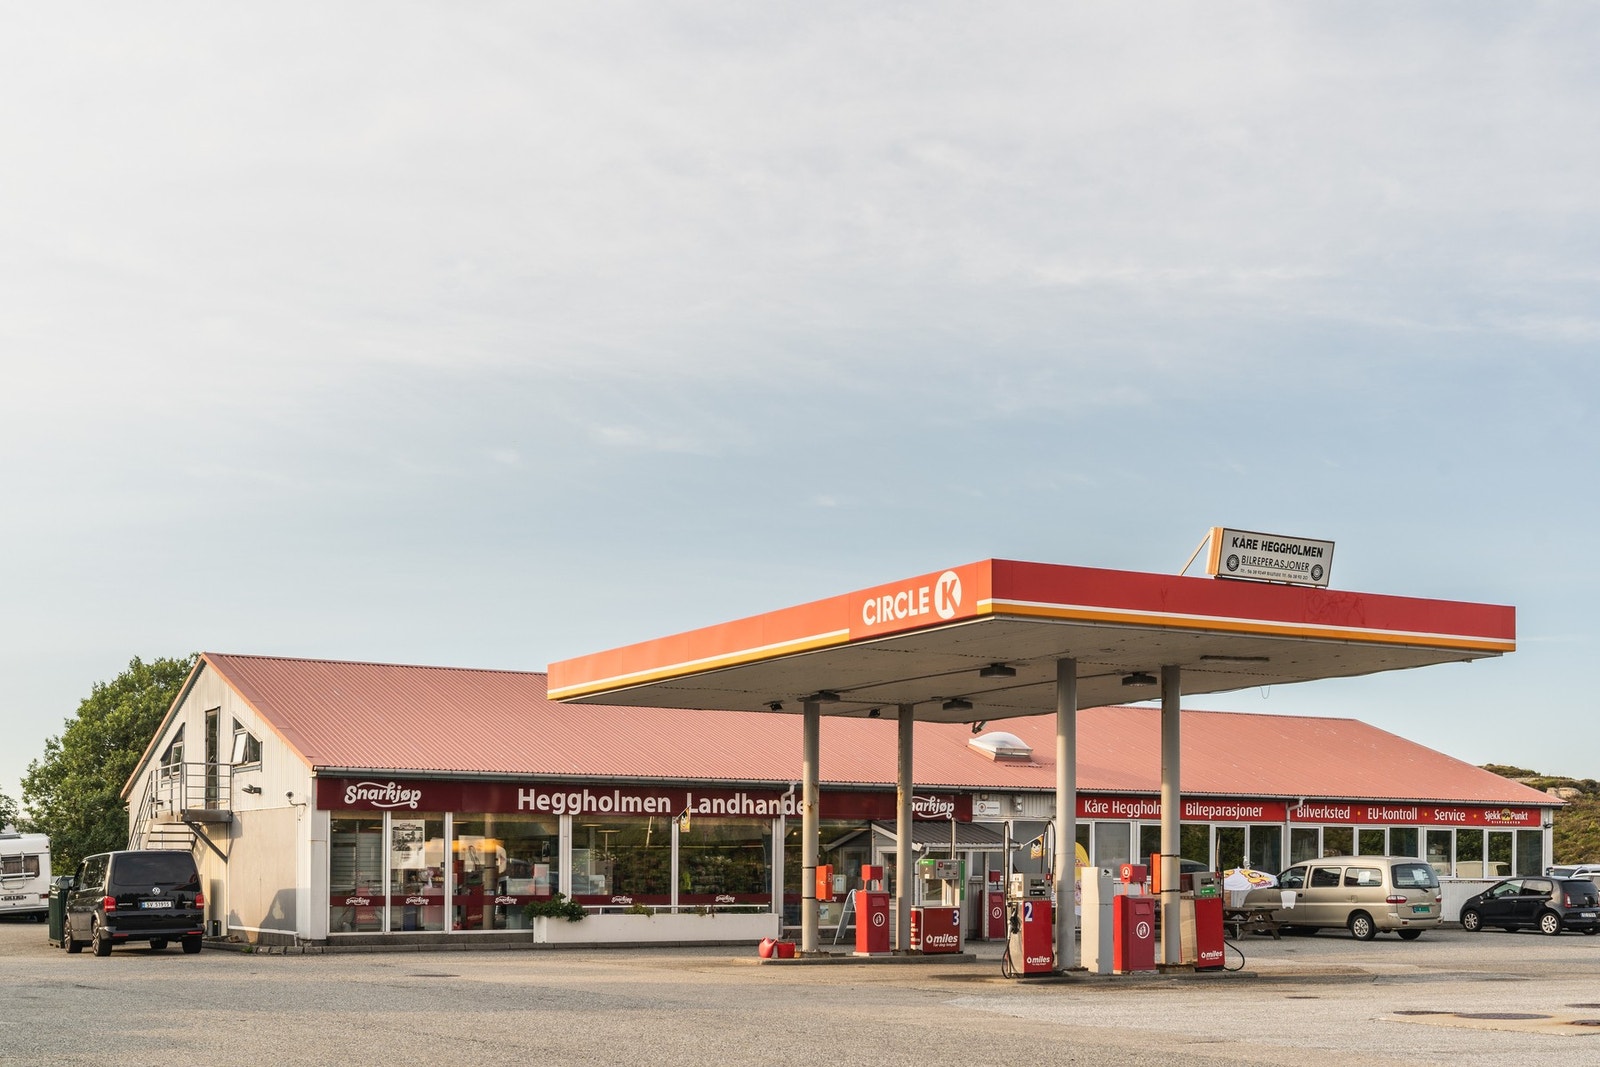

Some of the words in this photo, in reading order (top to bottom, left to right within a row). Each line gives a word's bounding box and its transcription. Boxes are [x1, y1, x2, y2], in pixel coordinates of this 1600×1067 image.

[1232, 535, 1259, 550] KÅRE
[1260, 541, 1324, 558] HEGGHOLMEN
[1241, 555, 1310, 571] BILREPERASJONER
[862, 586, 930, 626] CIRCLE
[938, 574, 960, 615] K
[344, 781, 422, 809] Snarkjøp
[518, 788, 671, 815] Heggholmen
[686, 792, 804, 816] Landhande
[912, 796, 955, 819] arkjøp
[1084, 798, 1109, 814] Kåre
[1185, 803, 1263, 820] Bilreparasjoner
[1296, 805, 1350, 819] Bilverksted
[1367, 806, 1418, 820] EU-kontroll
[1434, 809, 1466, 821] Service
[953, 910, 960, 926] 3
[1024, 901, 1033, 922] 2
[933, 934, 958, 943] miles
